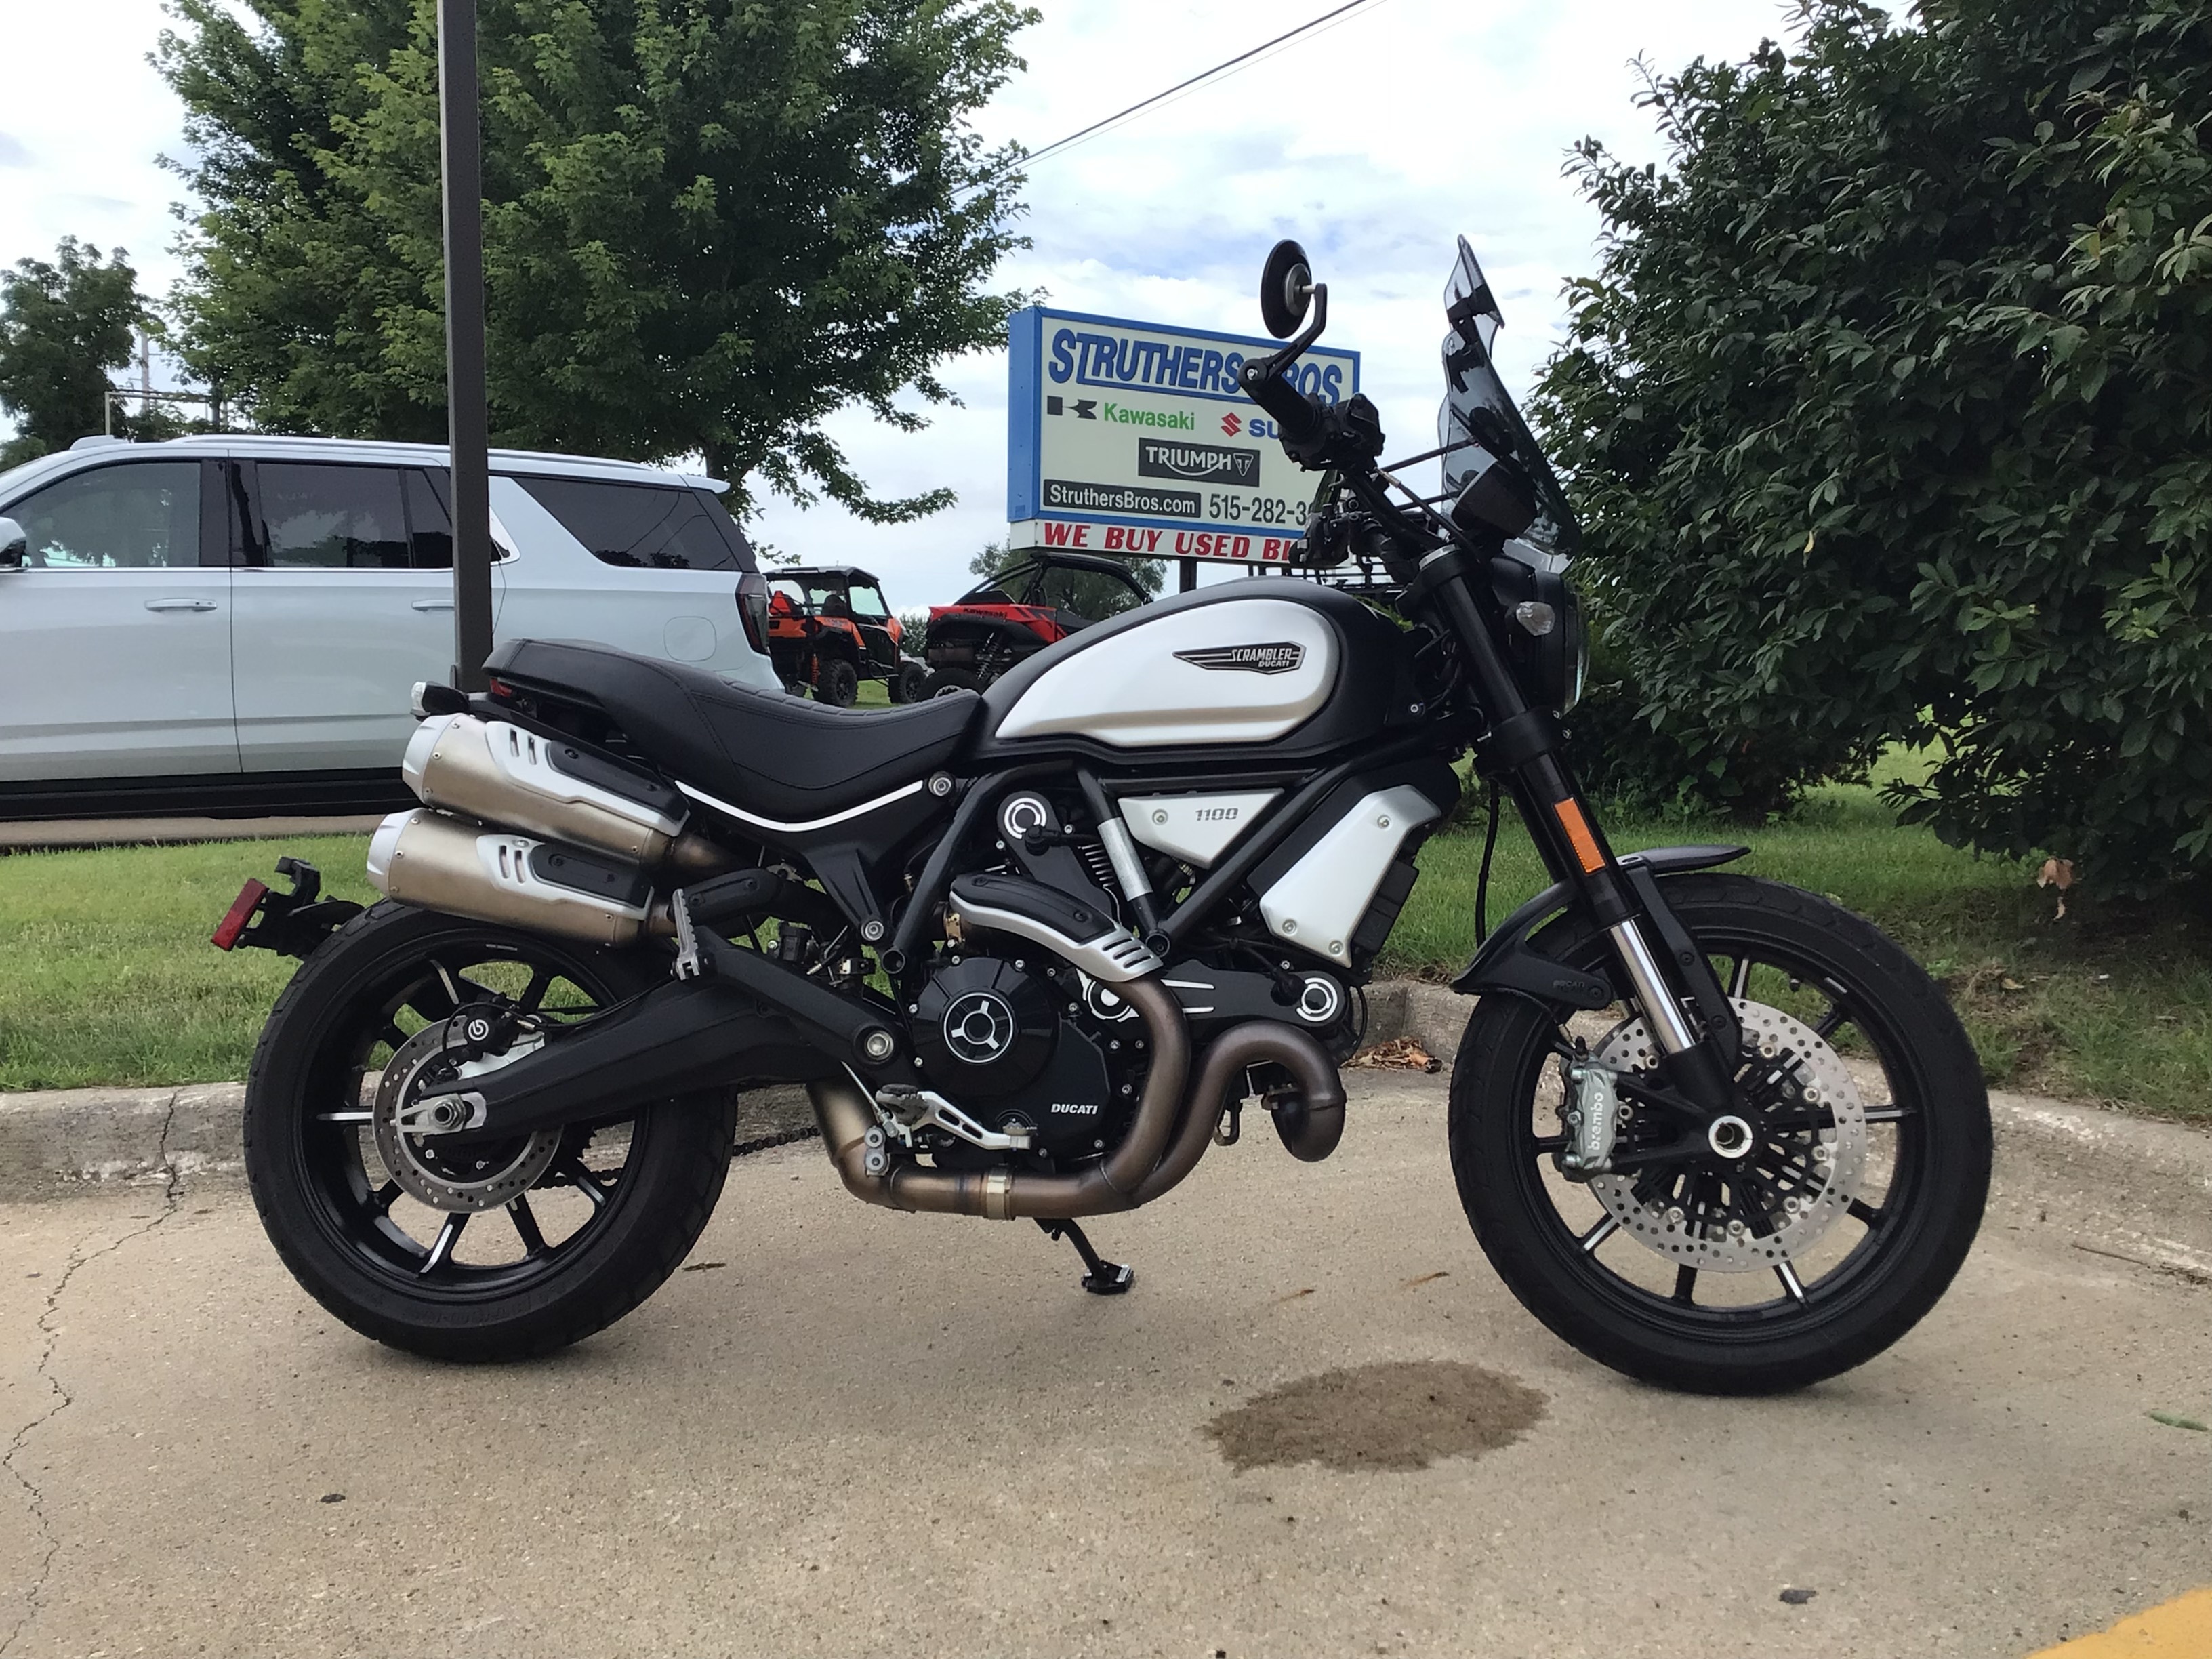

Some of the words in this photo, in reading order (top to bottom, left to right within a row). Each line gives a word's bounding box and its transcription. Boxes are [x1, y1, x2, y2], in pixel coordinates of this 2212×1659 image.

[1048, 328, 1244, 394] STRUTHERS
[1280, 362, 1343, 407] ROS
[1104, 402, 1195, 430] Kawasaki
[1145, 445, 1231, 476] TRIUMPH
[1050, 484, 1195, 514] StruthersBros.com
[1209, 493, 1313, 526] 515-282-3
[1044, 523, 1091, 548] WE
[1104, 527, 1163, 552] BUY
[1174, 532, 1250, 558] USED
[1231, 648, 1293, 662] SCRAMBLER
[1195, 808, 1239, 821] 1100
[1051, 1103, 1099, 1115] DUCATI
[1587, 1092, 1604, 1151] brembo
